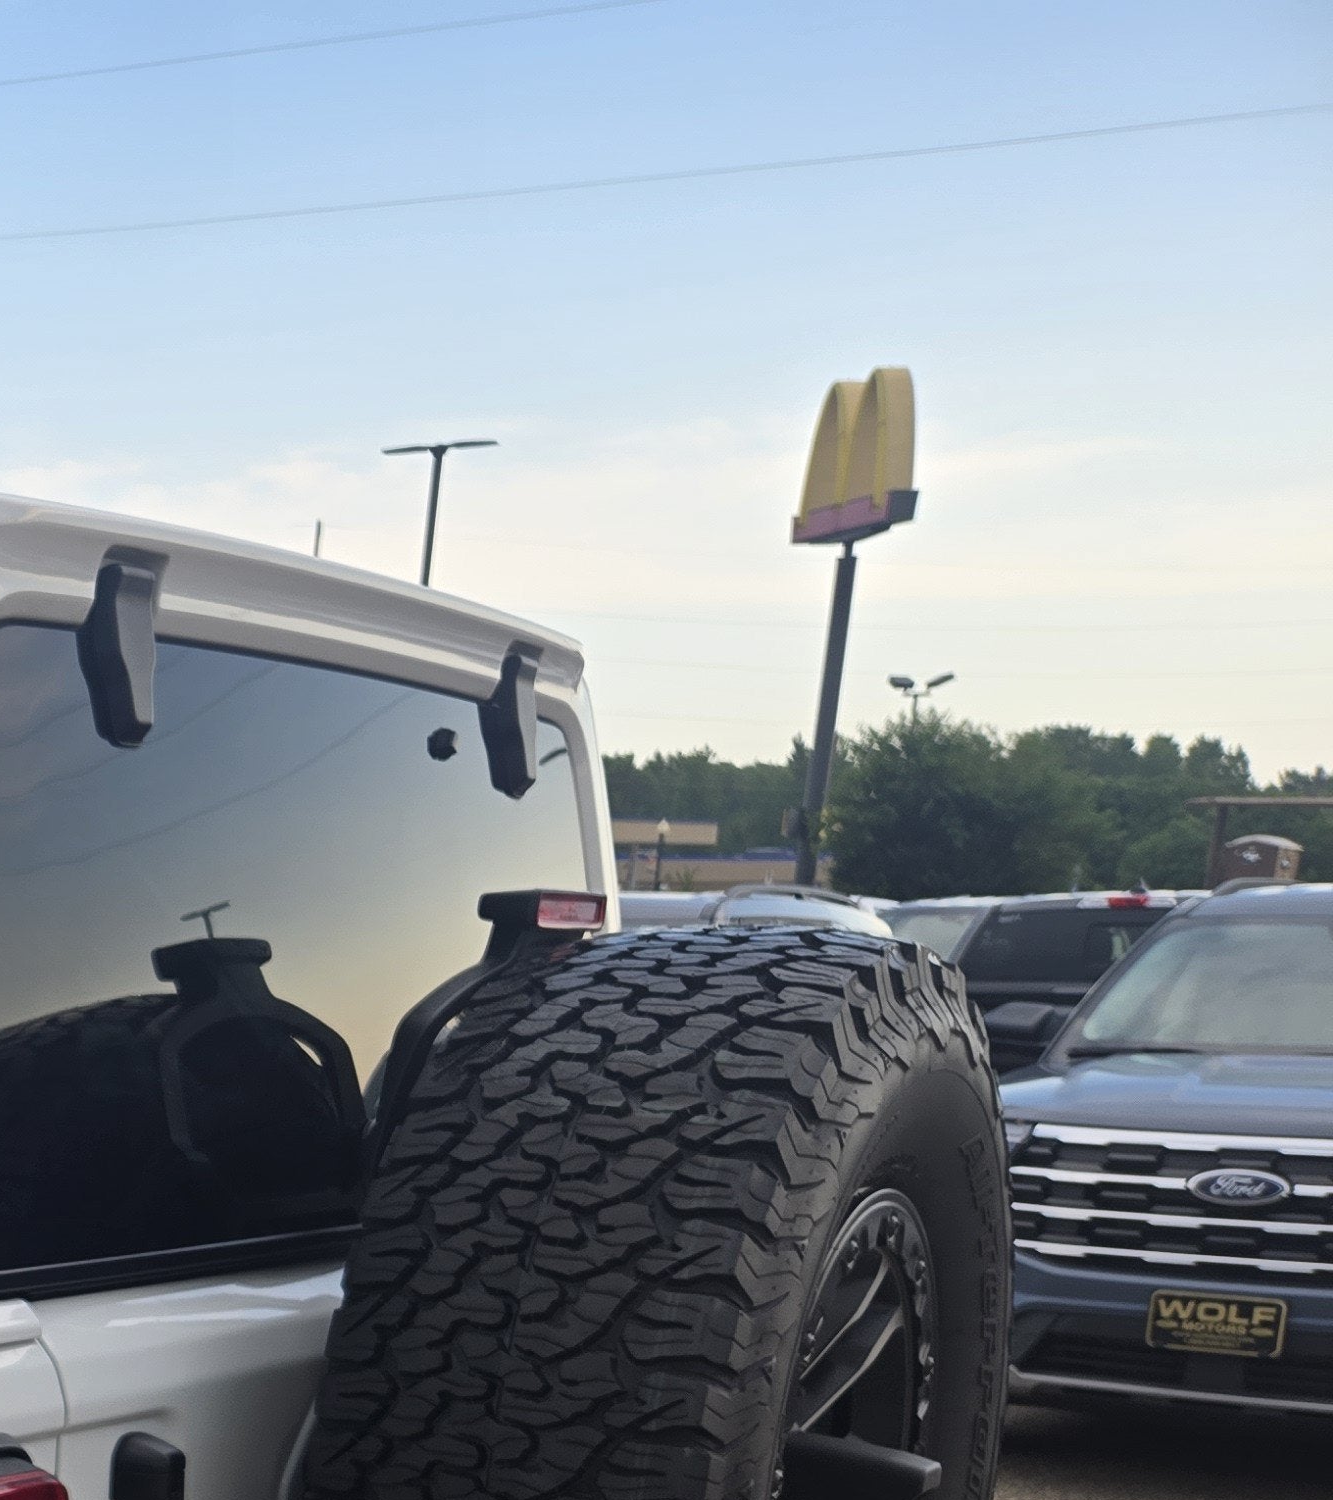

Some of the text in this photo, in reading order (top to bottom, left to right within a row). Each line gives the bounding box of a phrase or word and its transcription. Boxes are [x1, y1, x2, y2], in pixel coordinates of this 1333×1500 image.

[1210, 1175, 1266, 1197] Ford
[1158, 1299, 1277, 1325] WOLF
[1182, 1322, 1247, 1335] MOTORS
